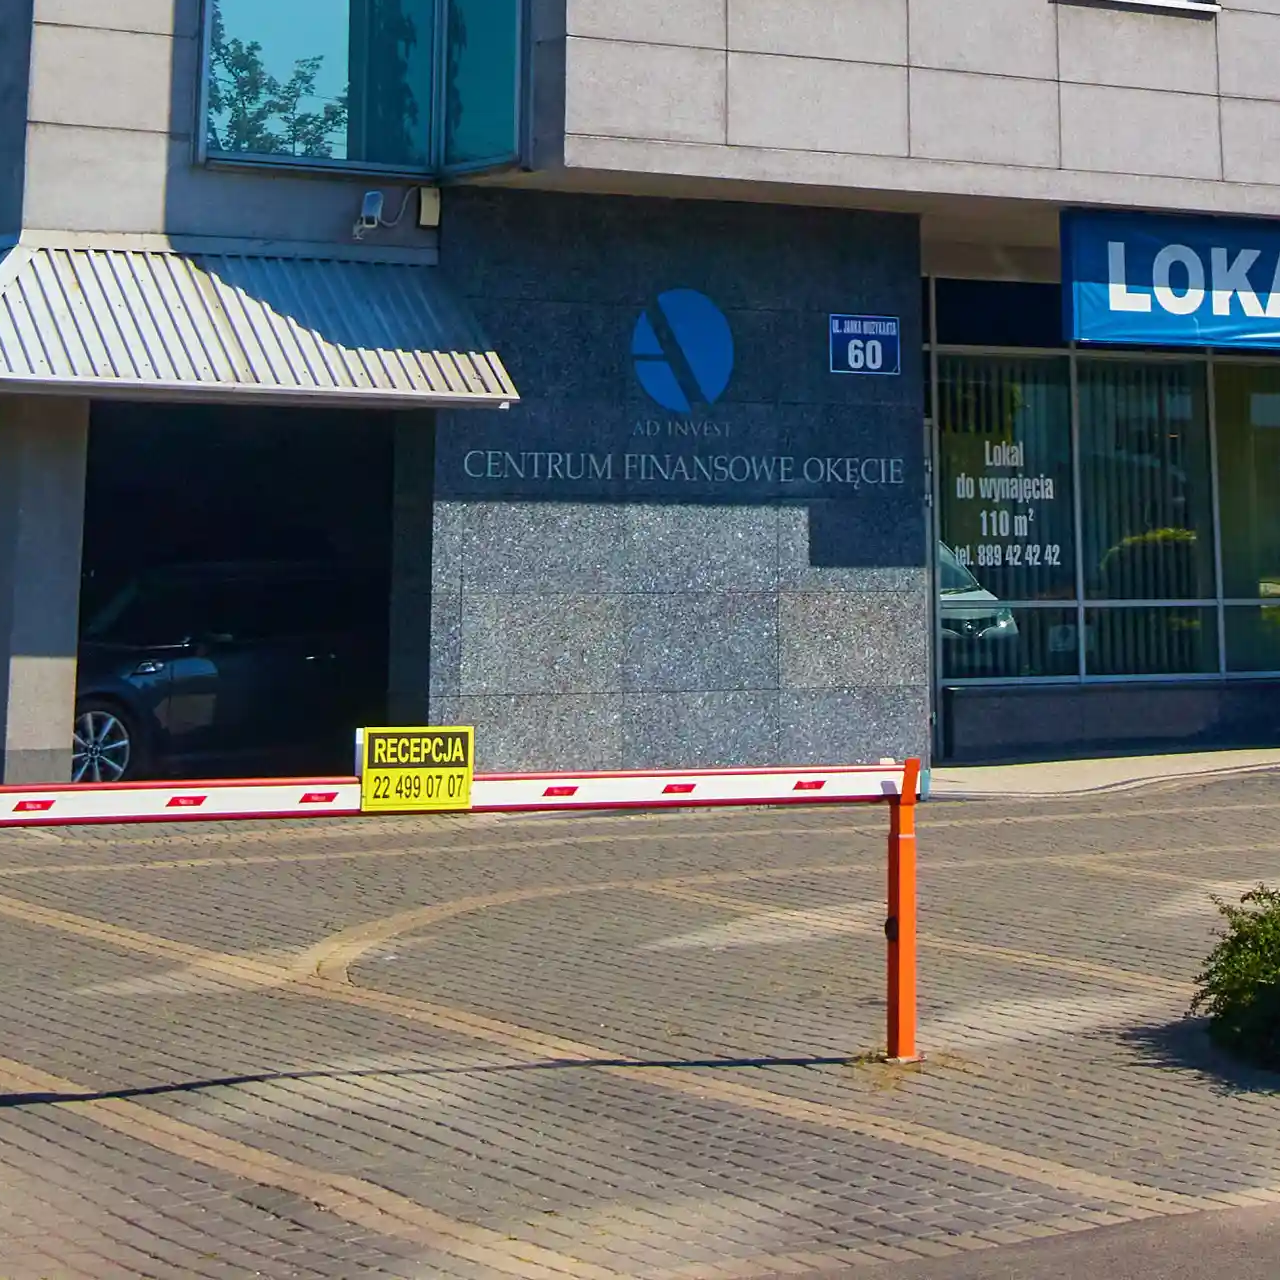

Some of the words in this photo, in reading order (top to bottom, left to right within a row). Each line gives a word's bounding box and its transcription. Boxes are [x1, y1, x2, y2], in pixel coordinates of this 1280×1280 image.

[848, 339, 882, 370] 60
[632, 420, 660, 437] AD
[667, 420, 732, 438] INVEST
[984, 440, 1024, 467] Lokal
[463, 449, 612, 480] CENTRUM
[623, 452, 795, 483] FINANSOWE
[802, 456, 905, 490] OKĘCIE
[956, 473, 975, 499] do
[979, 473, 1054, 505] wynajęcia
[980, 509, 1009, 537] 110
[955, 544, 975, 567] tel.
[978, 543, 1002, 567] 889
[1006, 543, 1022, 567] 42
[1025, 543, 1041, 567] 42
[1044, 543, 1061, 567] 42
[373, 736, 465, 764] RECEPCJA
[372, 775, 390, 799] 22
[395, 775, 421, 799] 499
[426, 775, 443, 798] 07
[448, 774, 465, 798] 07
